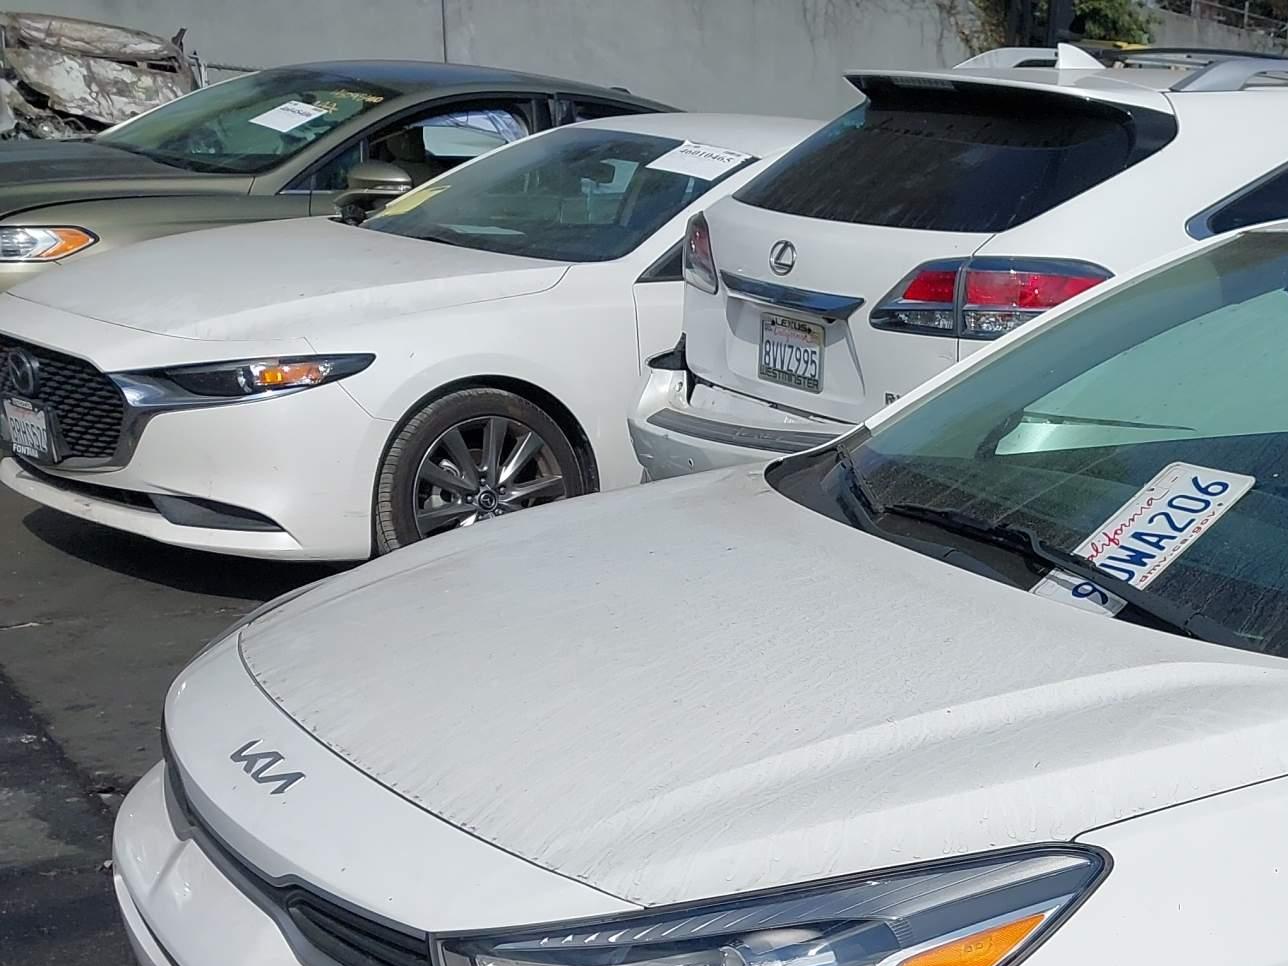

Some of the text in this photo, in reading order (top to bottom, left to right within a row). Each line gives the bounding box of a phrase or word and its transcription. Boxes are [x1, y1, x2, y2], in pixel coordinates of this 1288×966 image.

[775, 317, 807, 332] LEXUS
[763, 340, 817, 378] 8VVZ995
[1087, 489, 1169, 560] alifornia
[1138, 511, 1217, 584] dmv.ca.gov
